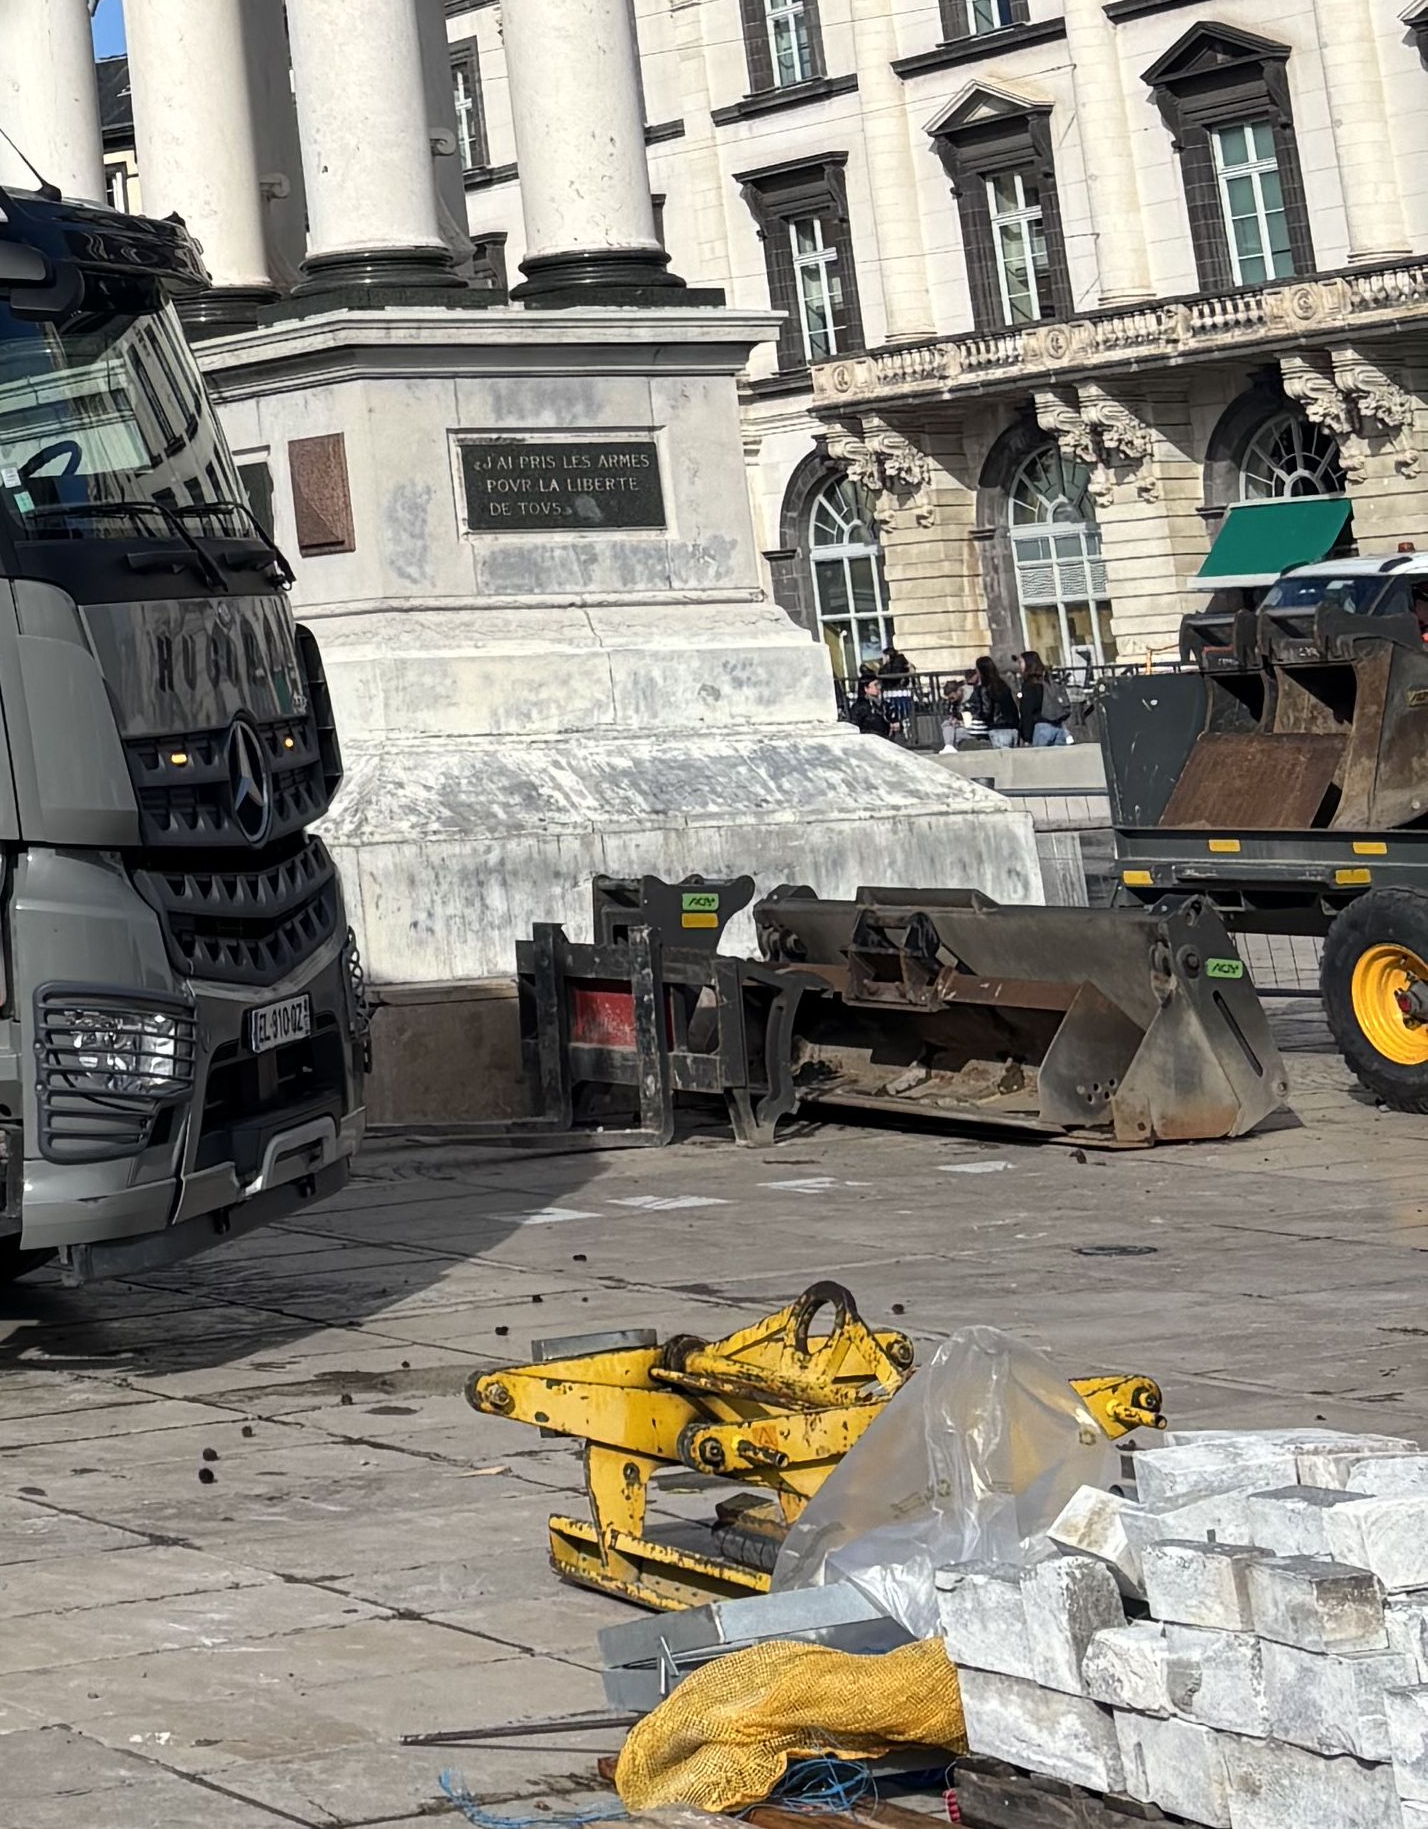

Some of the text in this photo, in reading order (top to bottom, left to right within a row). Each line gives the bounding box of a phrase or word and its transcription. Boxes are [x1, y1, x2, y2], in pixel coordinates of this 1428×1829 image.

[519, 455, 556, 470] PRIS
[563, 454, 591, 469] LES
[598, 454, 650, 469] ARMES
[538, 478, 560, 493] LA
[489, 502, 512, 516] DE
